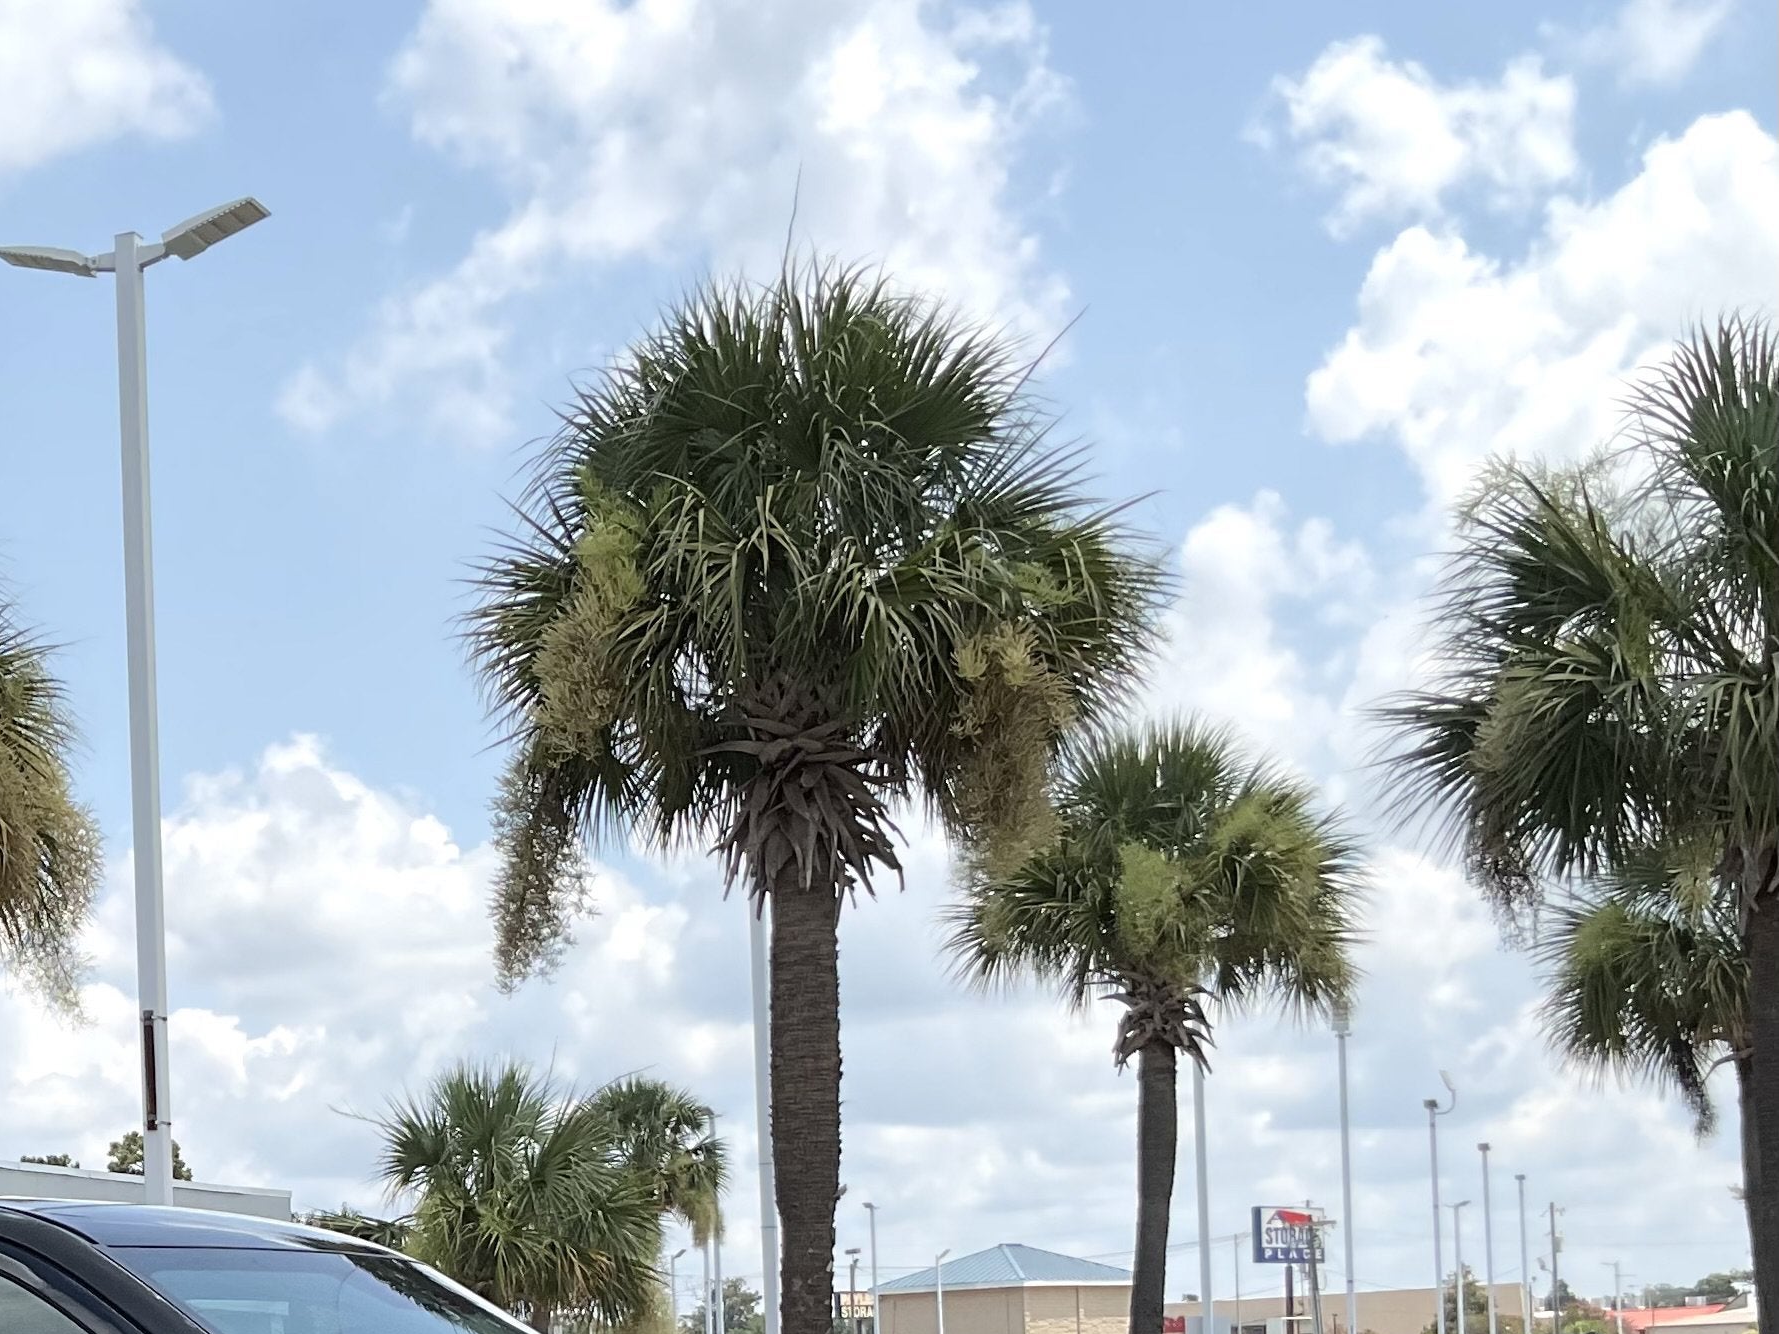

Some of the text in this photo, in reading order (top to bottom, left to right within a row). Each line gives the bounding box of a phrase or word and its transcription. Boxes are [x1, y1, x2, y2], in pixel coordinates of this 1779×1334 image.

[1265, 1226, 1320, 1246] STORA
[1264, 1248, 1323, 1260] PLACE
[841, 1305, 874, 1318] STORA
